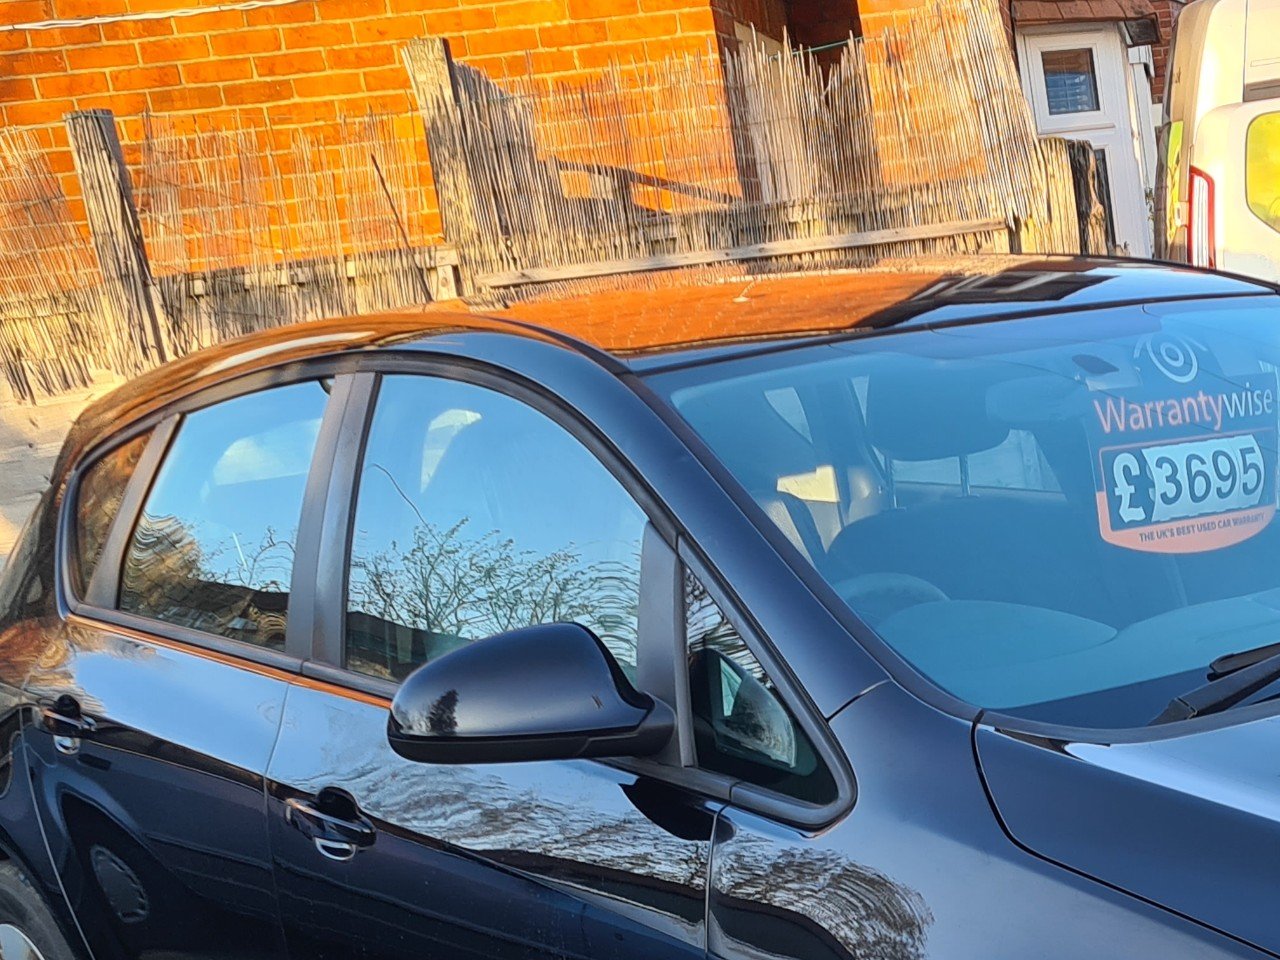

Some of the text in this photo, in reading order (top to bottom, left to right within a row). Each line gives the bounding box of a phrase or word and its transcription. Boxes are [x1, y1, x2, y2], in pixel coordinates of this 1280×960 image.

[1093, 382, 1273, 434] Warrantywise
[1112, 447, 1262, 523] £3695
[1139, 531, 1155, 542] THE
[1156, 529, 1175, 540] UK'S
[1176, 525, 1196, 537] BEST
[1196, 521, 1217, 533] USED
[1217, 519, 1231, 530] CAR
